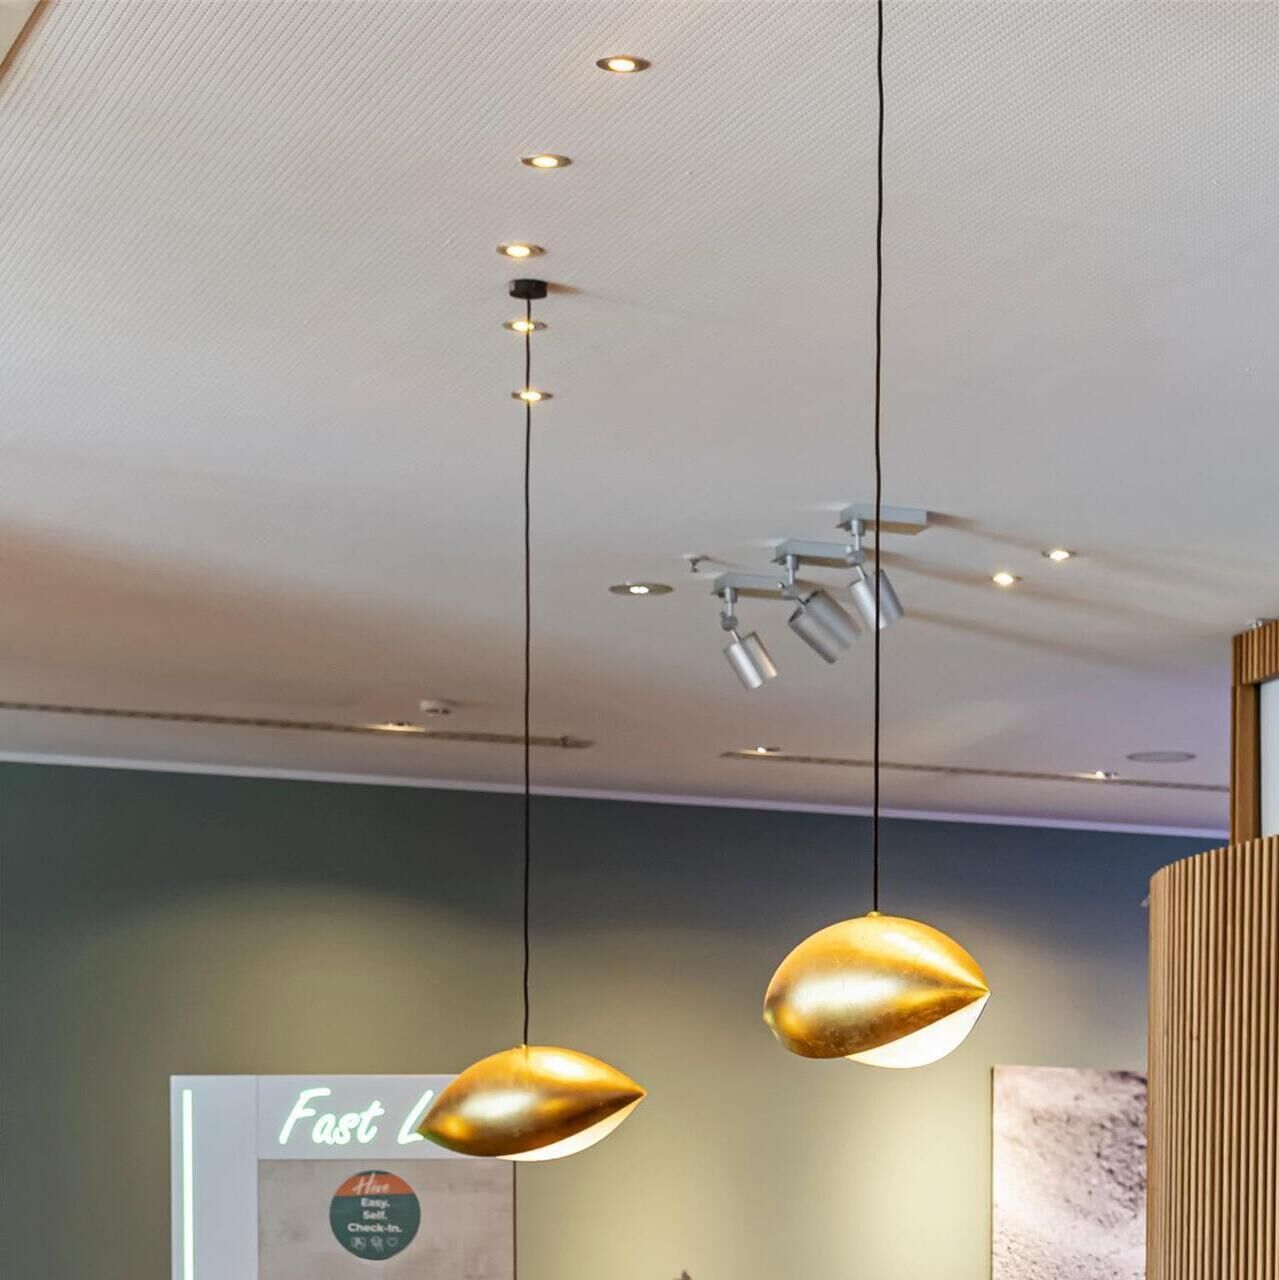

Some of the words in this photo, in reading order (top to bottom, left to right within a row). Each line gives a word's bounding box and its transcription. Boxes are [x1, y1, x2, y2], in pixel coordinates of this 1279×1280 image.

[279, 1087, 385, 1145] Fast
[361, 1197, 390, 1209] Easy.
[363, 1210, 388, 1220] Self.
